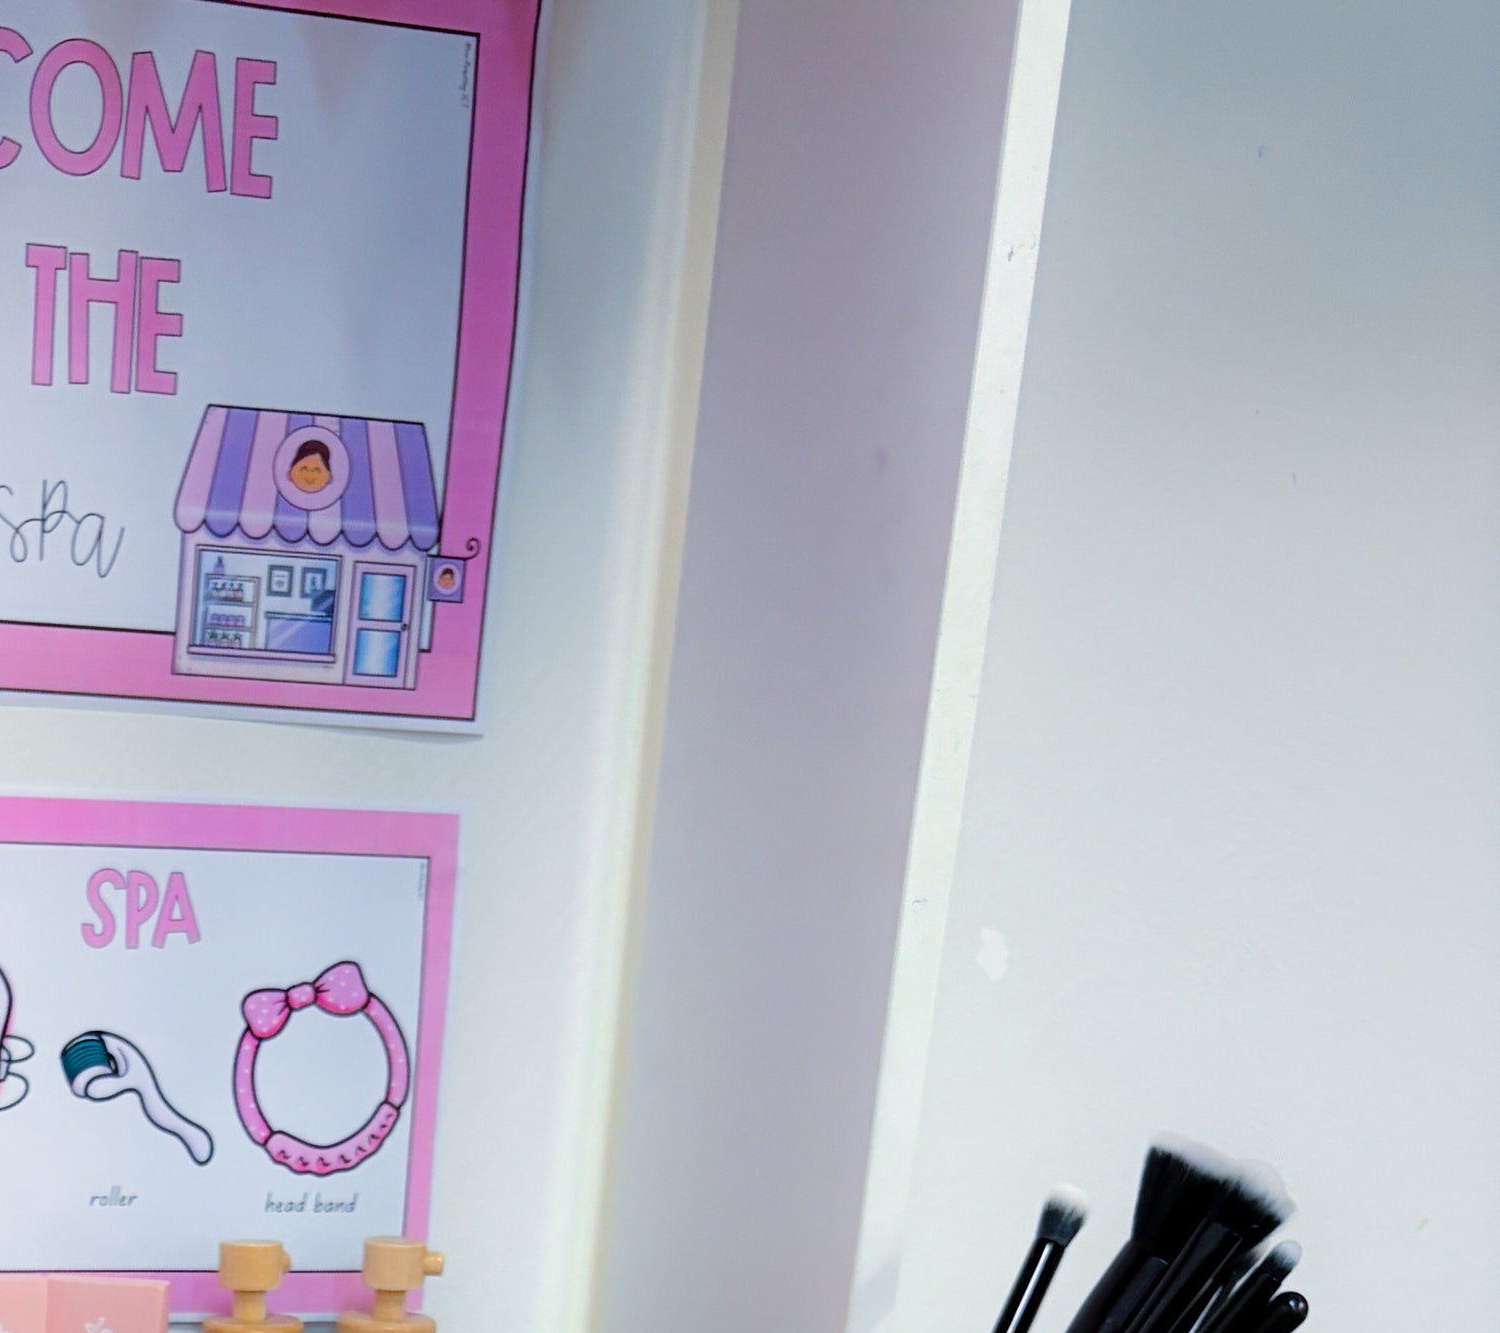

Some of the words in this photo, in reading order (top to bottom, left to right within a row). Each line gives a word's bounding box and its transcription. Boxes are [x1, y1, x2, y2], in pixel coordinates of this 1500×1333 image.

[25, 242, 184, 396] THE
[80, 868, 202, 949] SPA
[88, 1185, 138, 1208] roller
[263, 1192, 306, 1215] head
[314, 1192, 359, 1215] band
